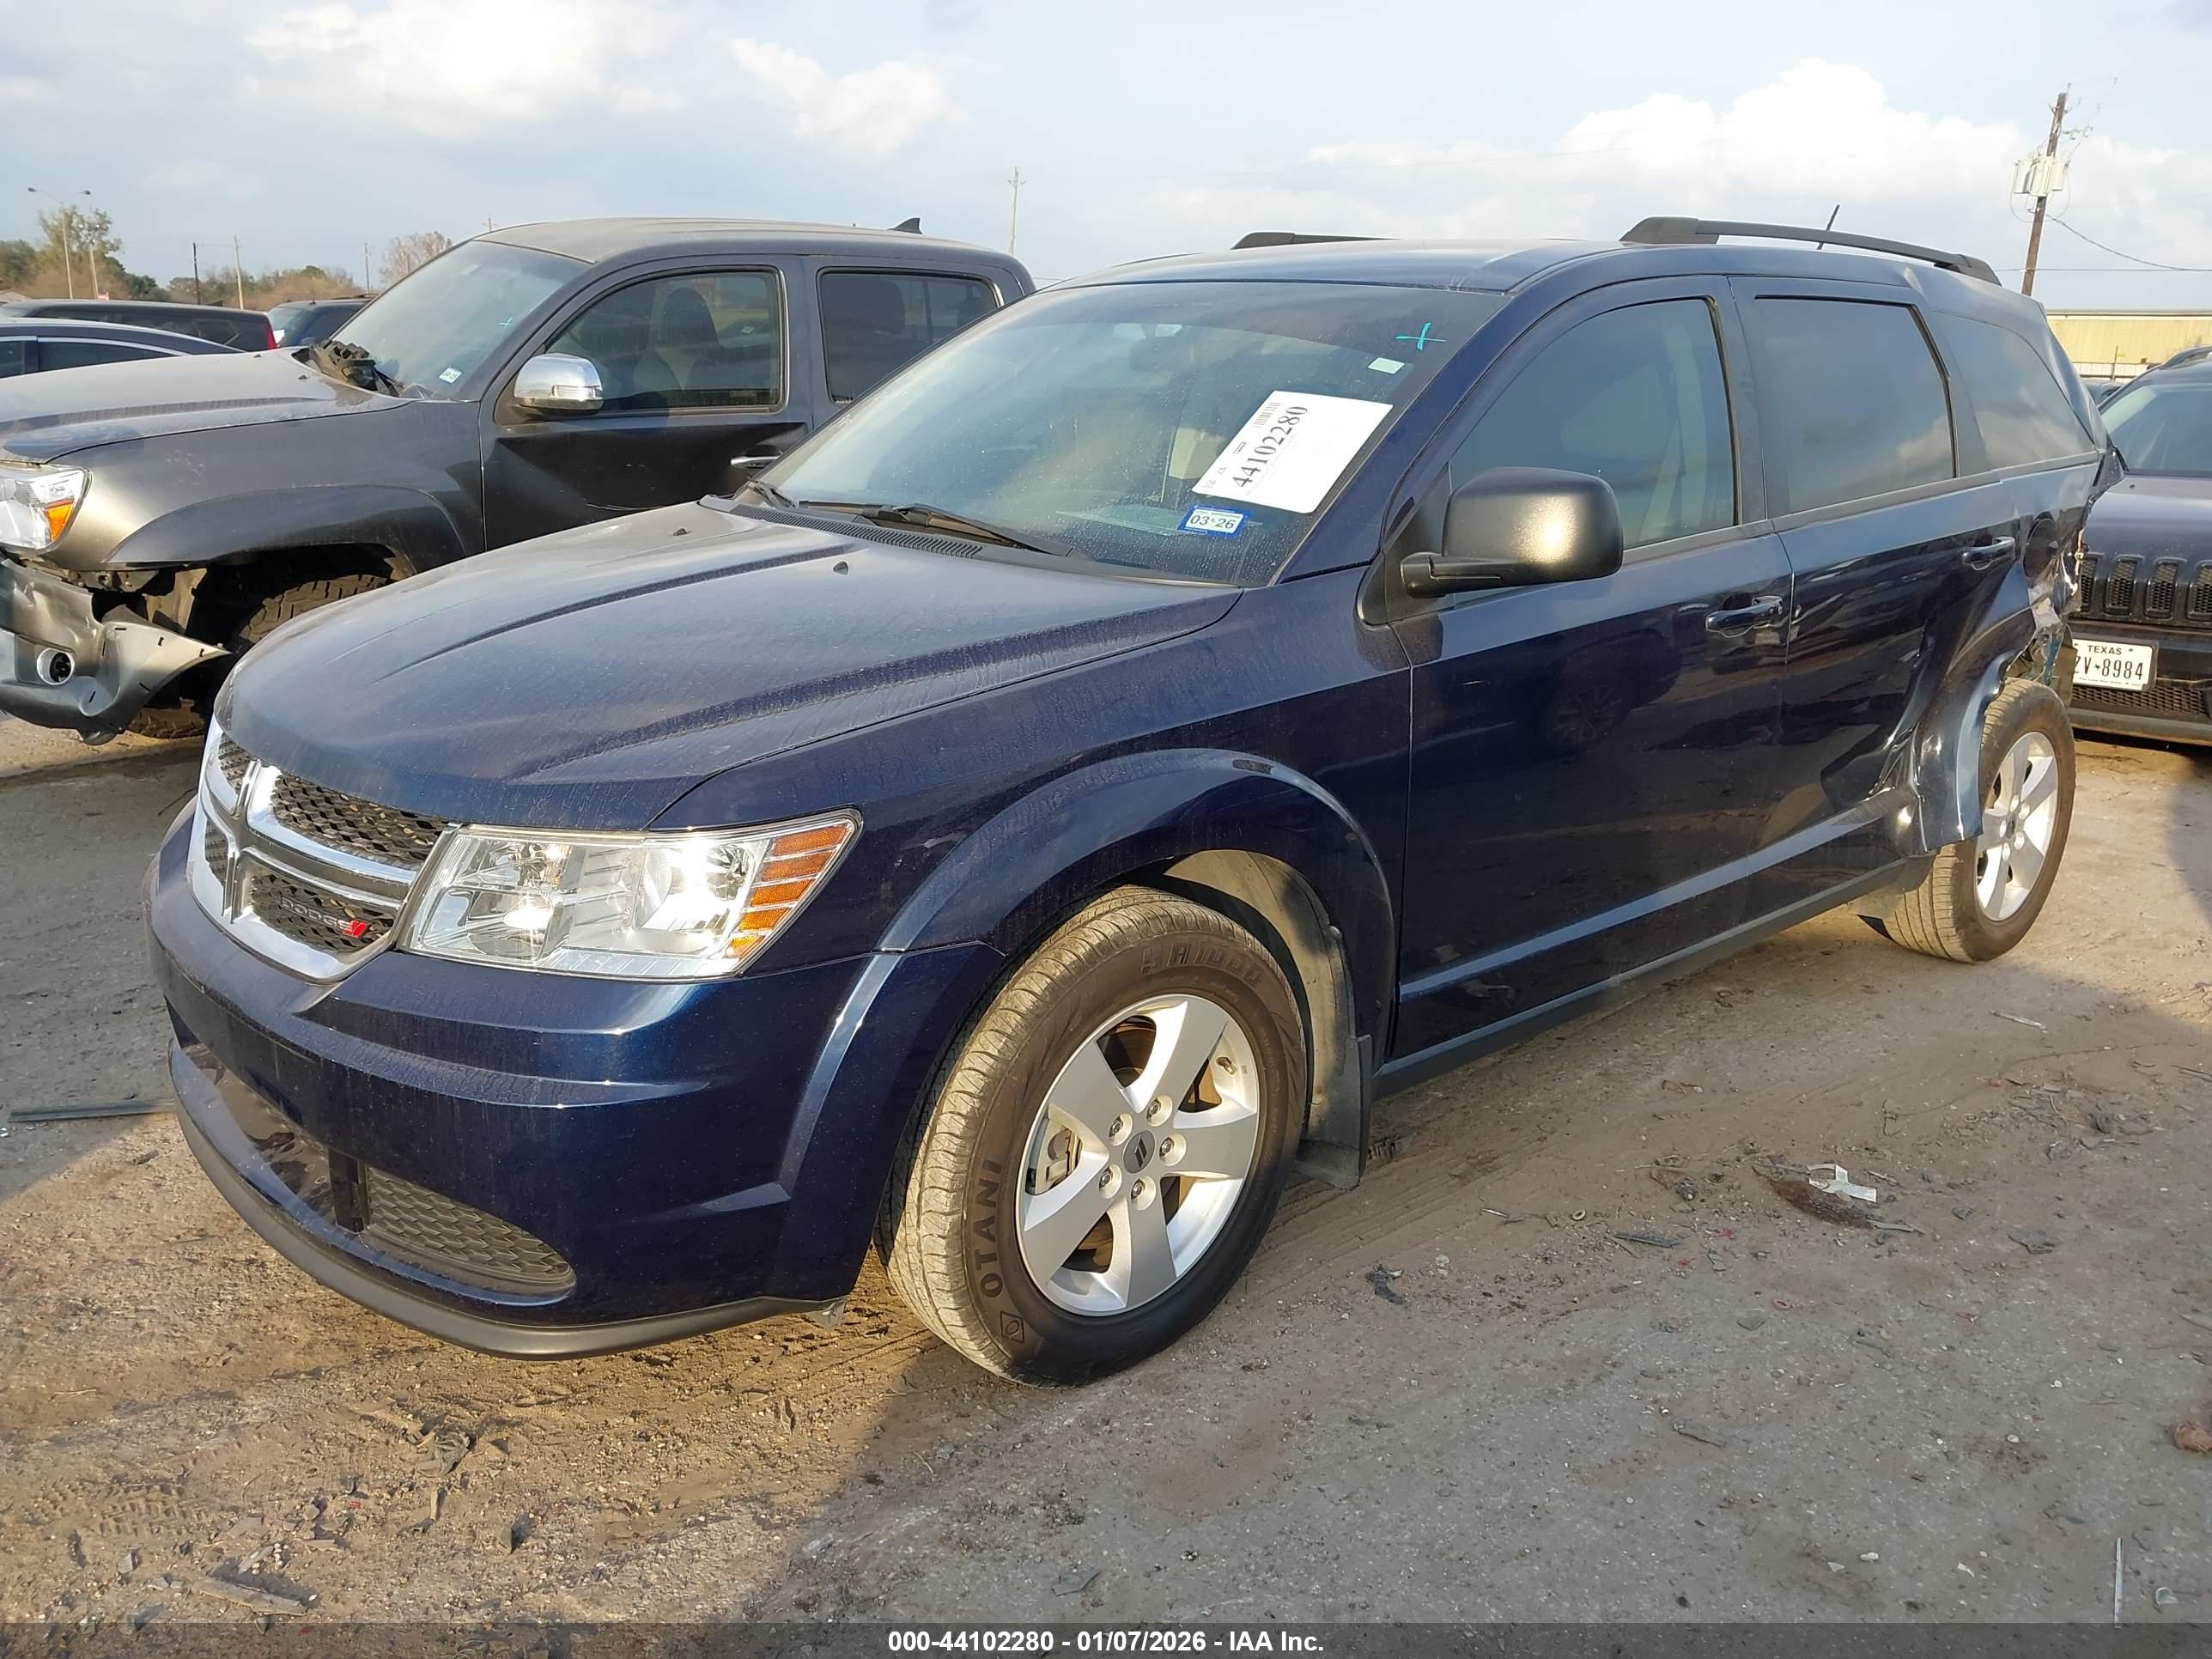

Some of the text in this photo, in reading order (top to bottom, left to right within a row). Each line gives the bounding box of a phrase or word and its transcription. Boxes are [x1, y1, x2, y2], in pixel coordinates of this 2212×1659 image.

[1231, 405, 1308, 488] 44102280
[2087, 645, 2123, 656] TEXAS
[282, 896, 353, 933] DODGE
[973, 1158, 1004, 1298] OTANI
